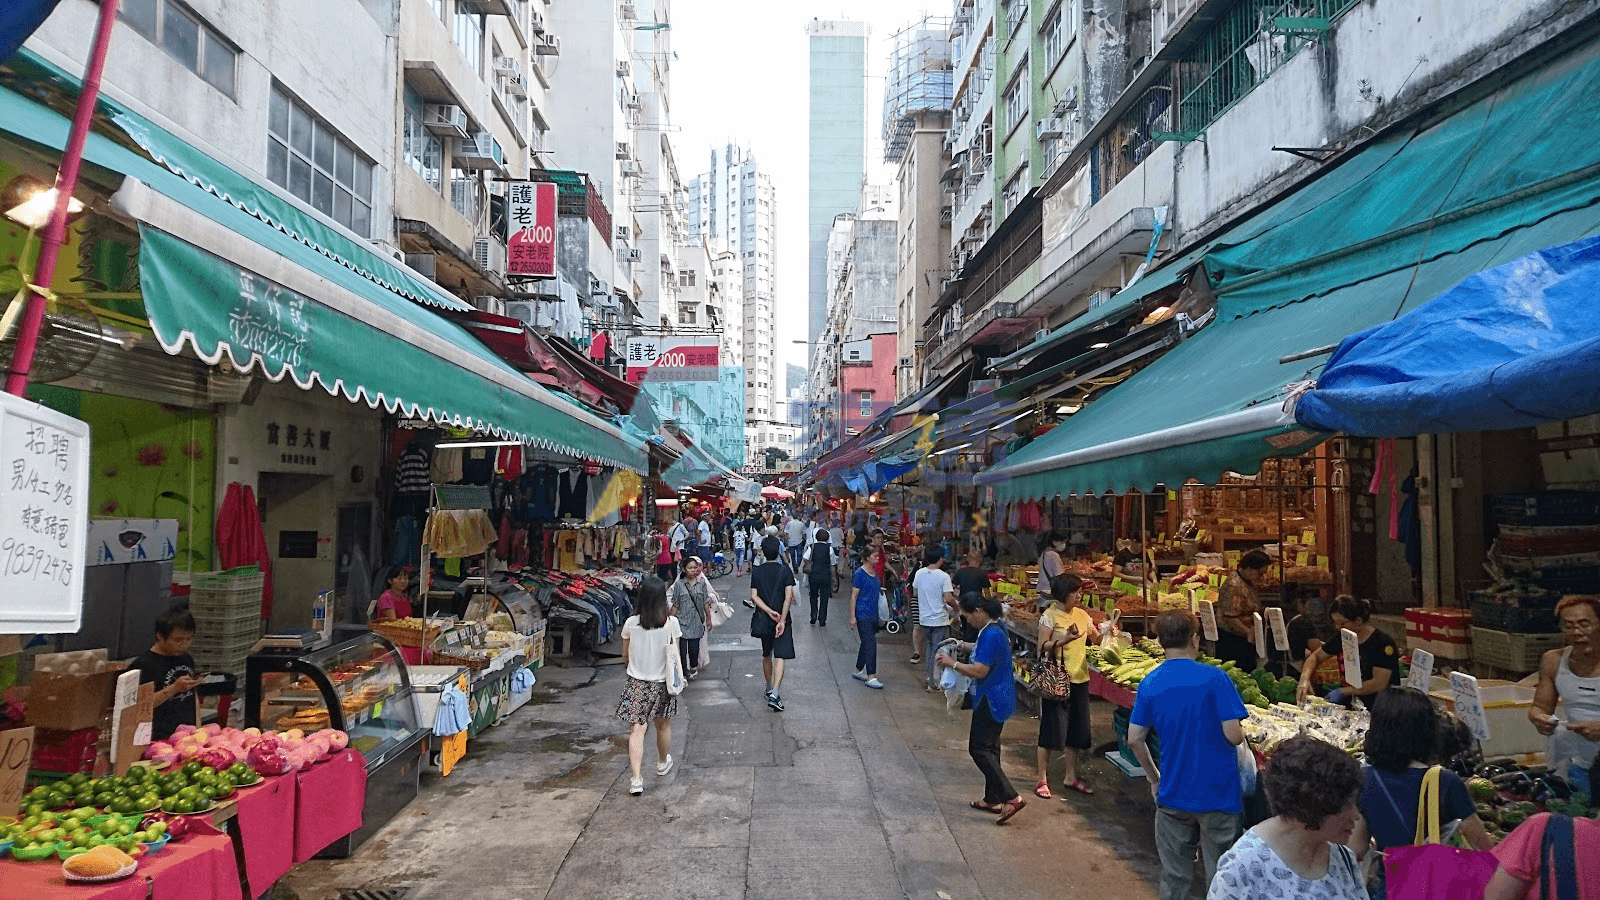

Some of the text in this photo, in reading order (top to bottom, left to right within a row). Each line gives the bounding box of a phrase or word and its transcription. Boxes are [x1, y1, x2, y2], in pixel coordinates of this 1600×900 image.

[512, 184, 532, 224] 護老
[520, 225, 553, 244] 2000
[512, 244, 550, 261] 安老院
[520, 261, 552, 273] 26502031
[629, 342, 657, 362] 護老
[657, 352, 686, 368] 2000
[686, 352, 717, 367] 安老院
[24, 421, 70, 472] 招聘
[2, 537, 73, 587] 98392473
